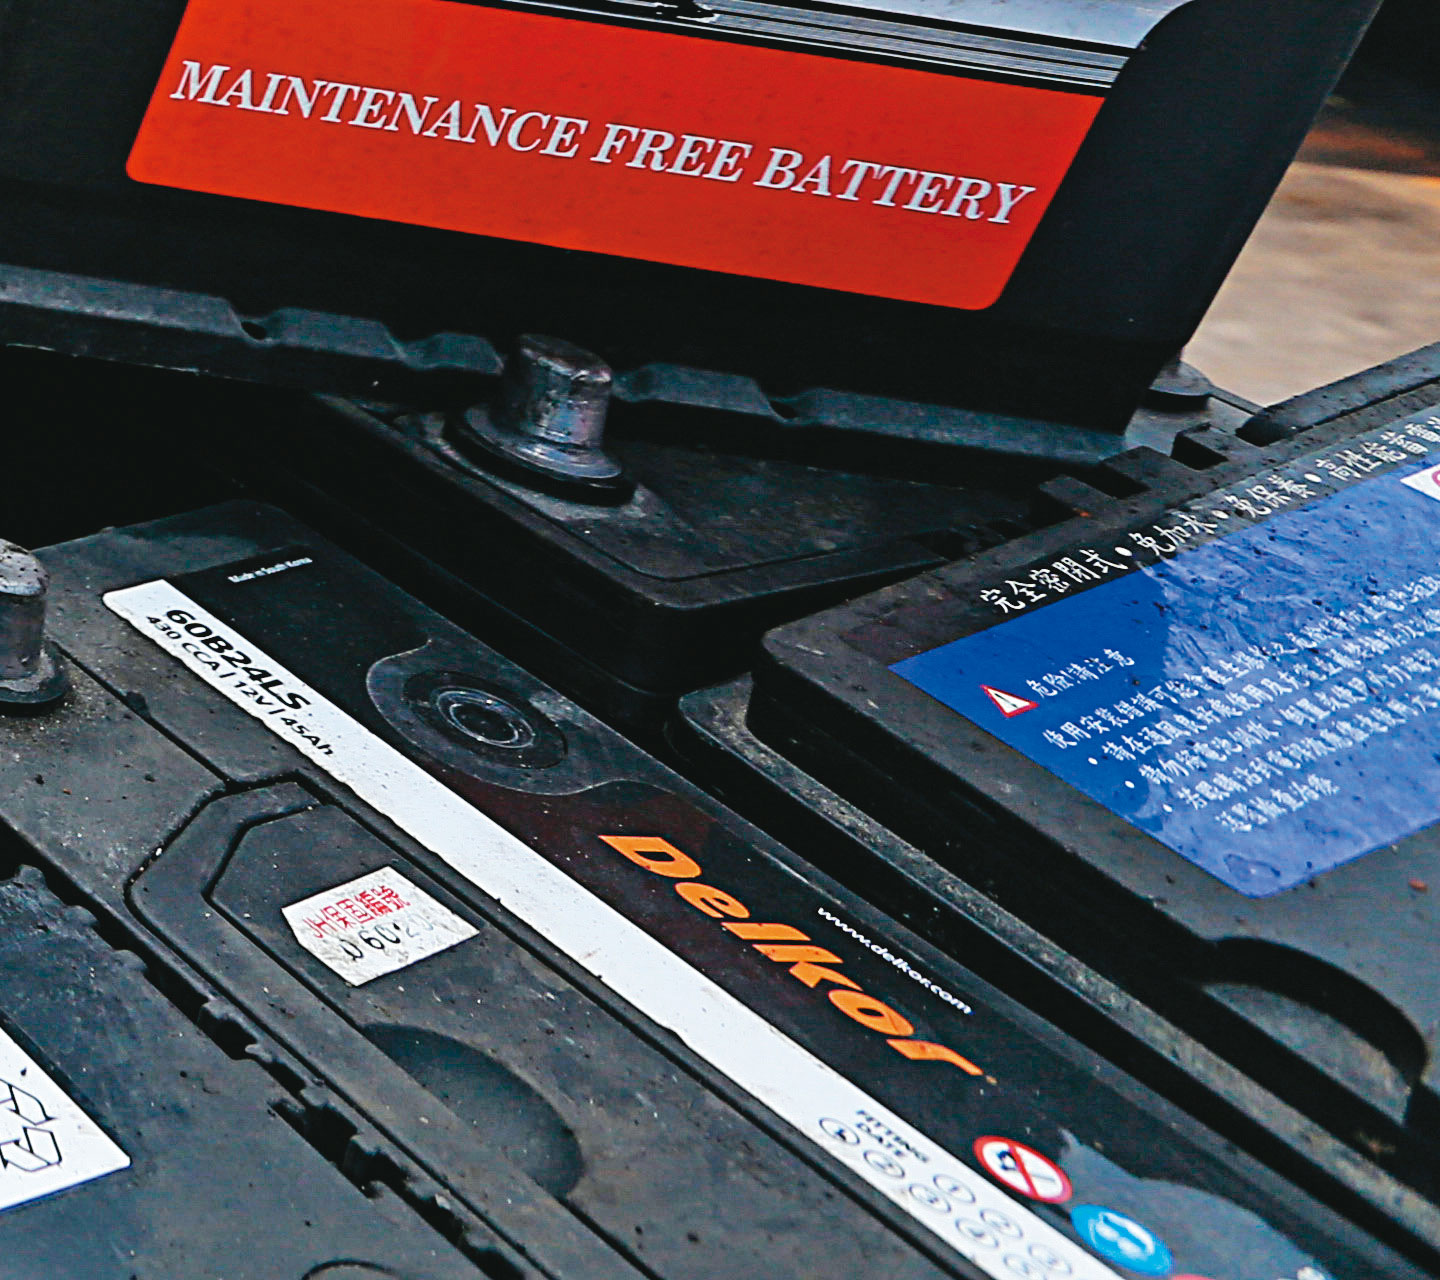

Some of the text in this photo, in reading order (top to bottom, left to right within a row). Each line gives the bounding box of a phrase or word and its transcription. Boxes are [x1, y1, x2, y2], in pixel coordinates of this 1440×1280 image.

[169, 60, 1034, 226] MAINTENANCE FREE BATTERY
[146, 615, 336, 757] 430 CCA 12V 45Ah
[166, 608, 312, 710] 60B24LS
[599, 834, 984, 1079] Delkor
[817, 904, 975, 1018] www.delkor.com
